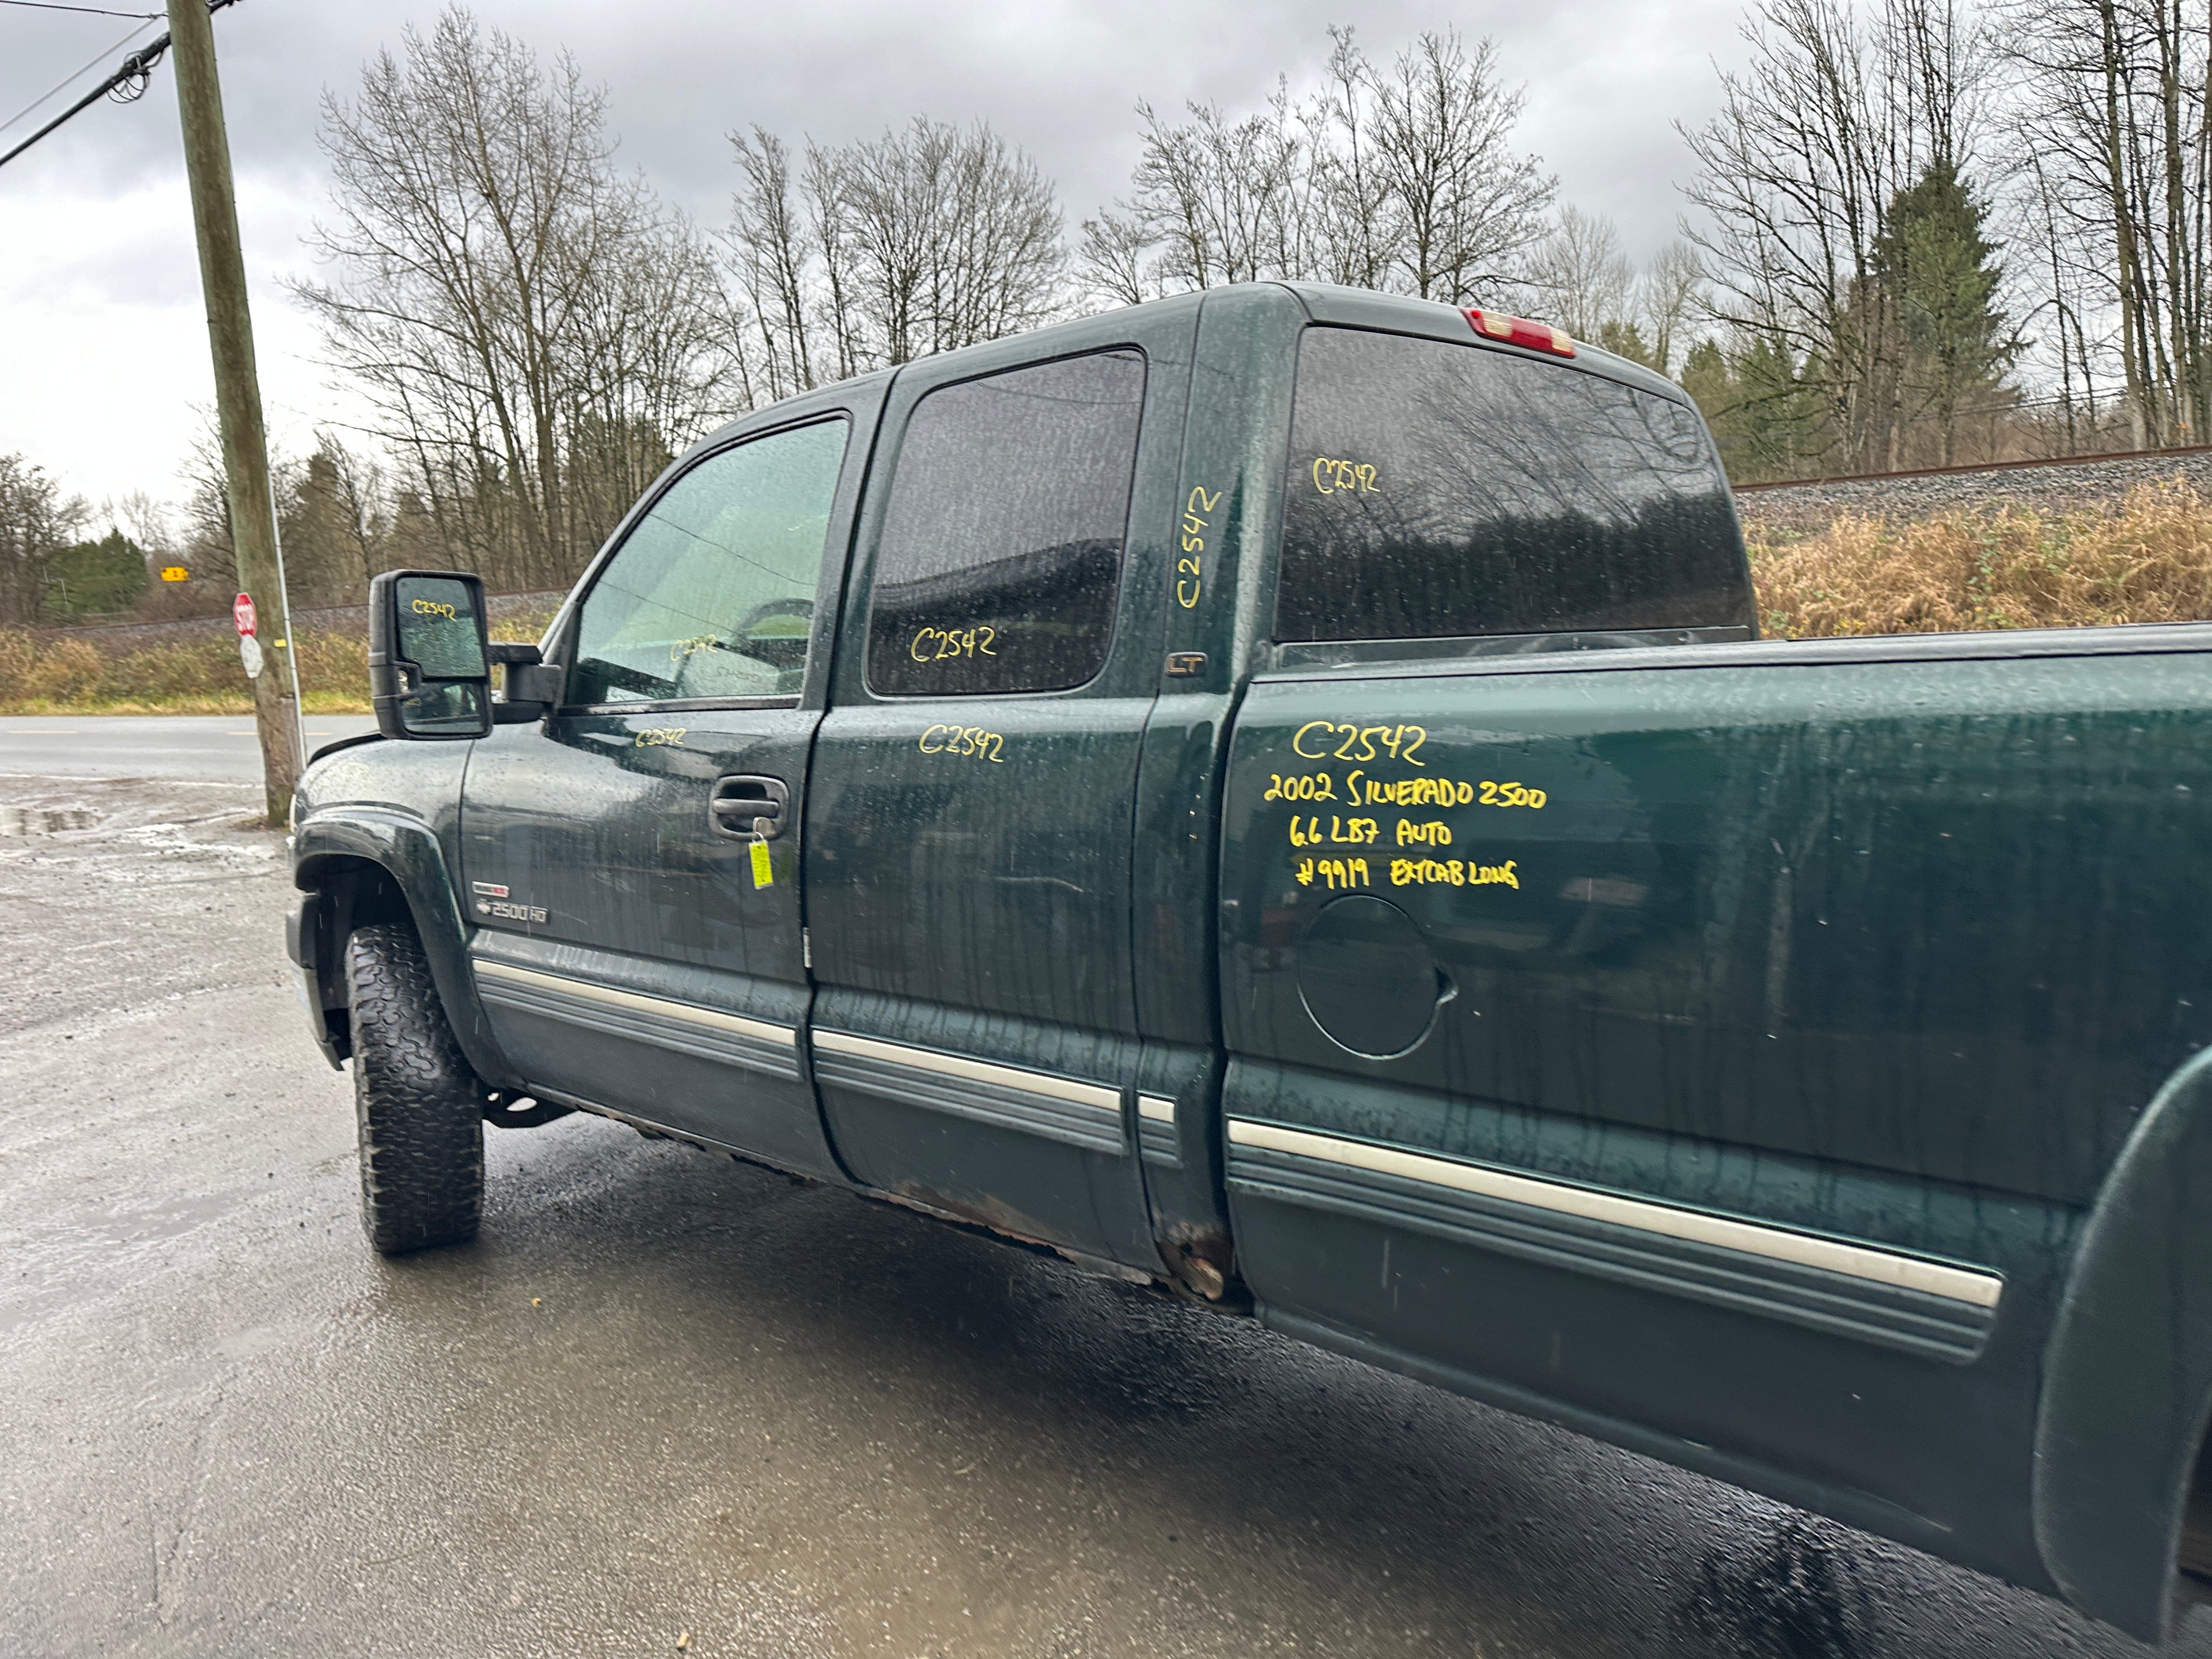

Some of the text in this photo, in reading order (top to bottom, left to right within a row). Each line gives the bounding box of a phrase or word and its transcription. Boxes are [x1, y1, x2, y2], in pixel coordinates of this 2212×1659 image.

[1313, 457, 1381, 494] C2542
[1177, 486, 1223, 608] C2542
[412, 599, 457, 622] C2542
[911, 626, 997, 662] C2542
[1168, 656, 1203, 673] LT
[919, 724, 1004, 763] C2542
[1293, 721, 1426, 766] C2542
[1264, 770, 1547, 808] 2002 SILVERADO 2500
[1331, 815, 1380, 844] LB7
[1396, 818, 1452, 846] AUTO
[1295, 858, 1369, 889] #9919
[492, 902, 548, 923] 2500 HD
